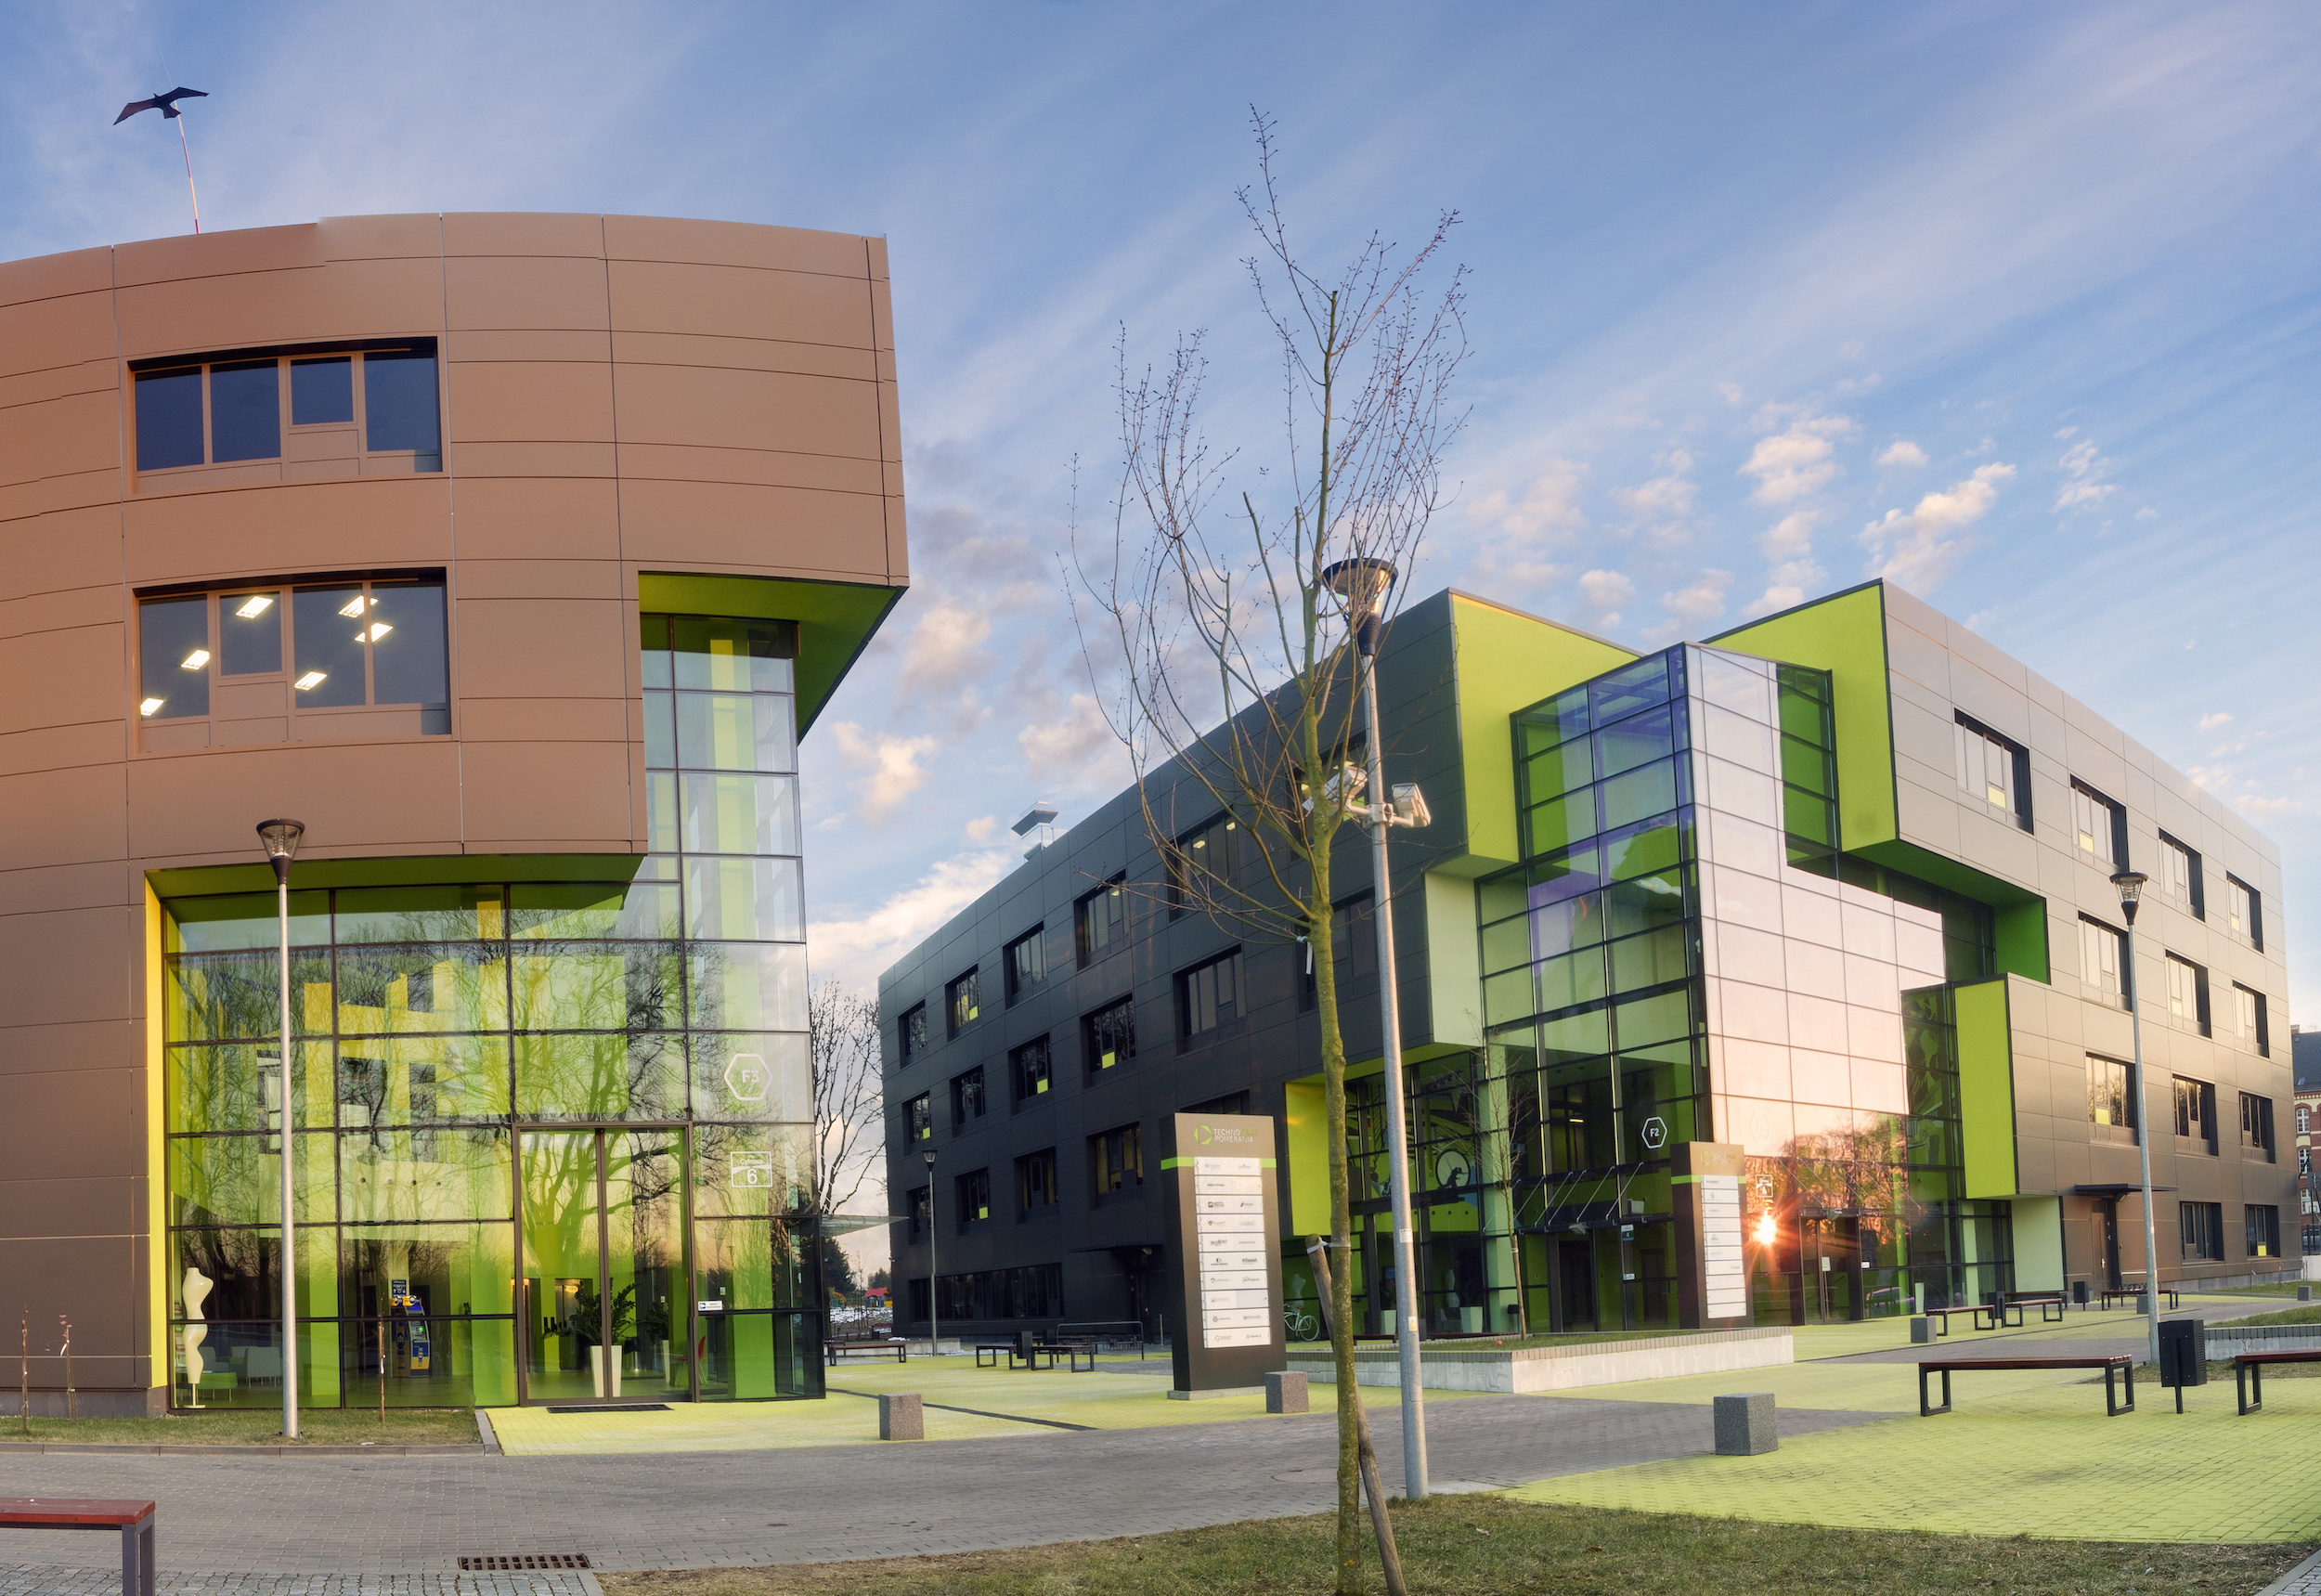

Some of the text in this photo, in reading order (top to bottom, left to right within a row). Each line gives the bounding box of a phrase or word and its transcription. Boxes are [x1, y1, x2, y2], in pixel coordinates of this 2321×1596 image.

[742, 1070, 759, 1083] F3
[1650, 1127, 1660, 1138] F2
[1214, 1135, 1254, 1143] POMERANIA
[746, 1168, 758, 1185] 6
